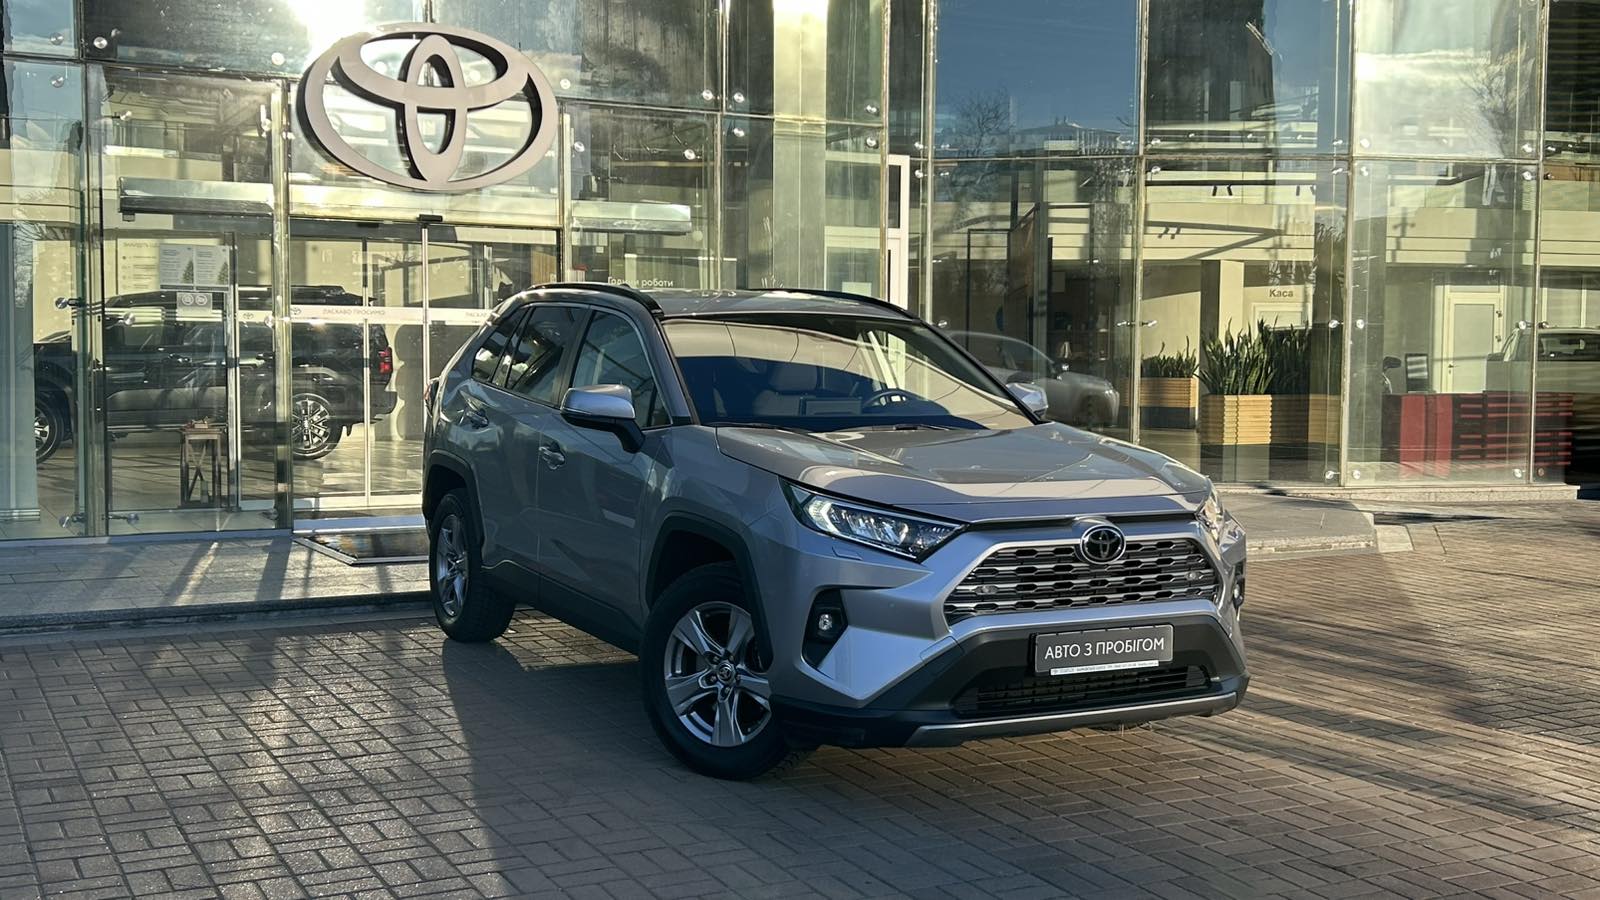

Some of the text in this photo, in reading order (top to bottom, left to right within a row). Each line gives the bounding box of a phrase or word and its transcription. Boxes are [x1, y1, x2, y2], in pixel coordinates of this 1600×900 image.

[641, 278, 674, 288] роботи
[1269, 289, 1294, 298] Каса
[1044, 643, 1081, 660] АВТО
[1095, 637, 1165, 655] ПРОБІГОМ
